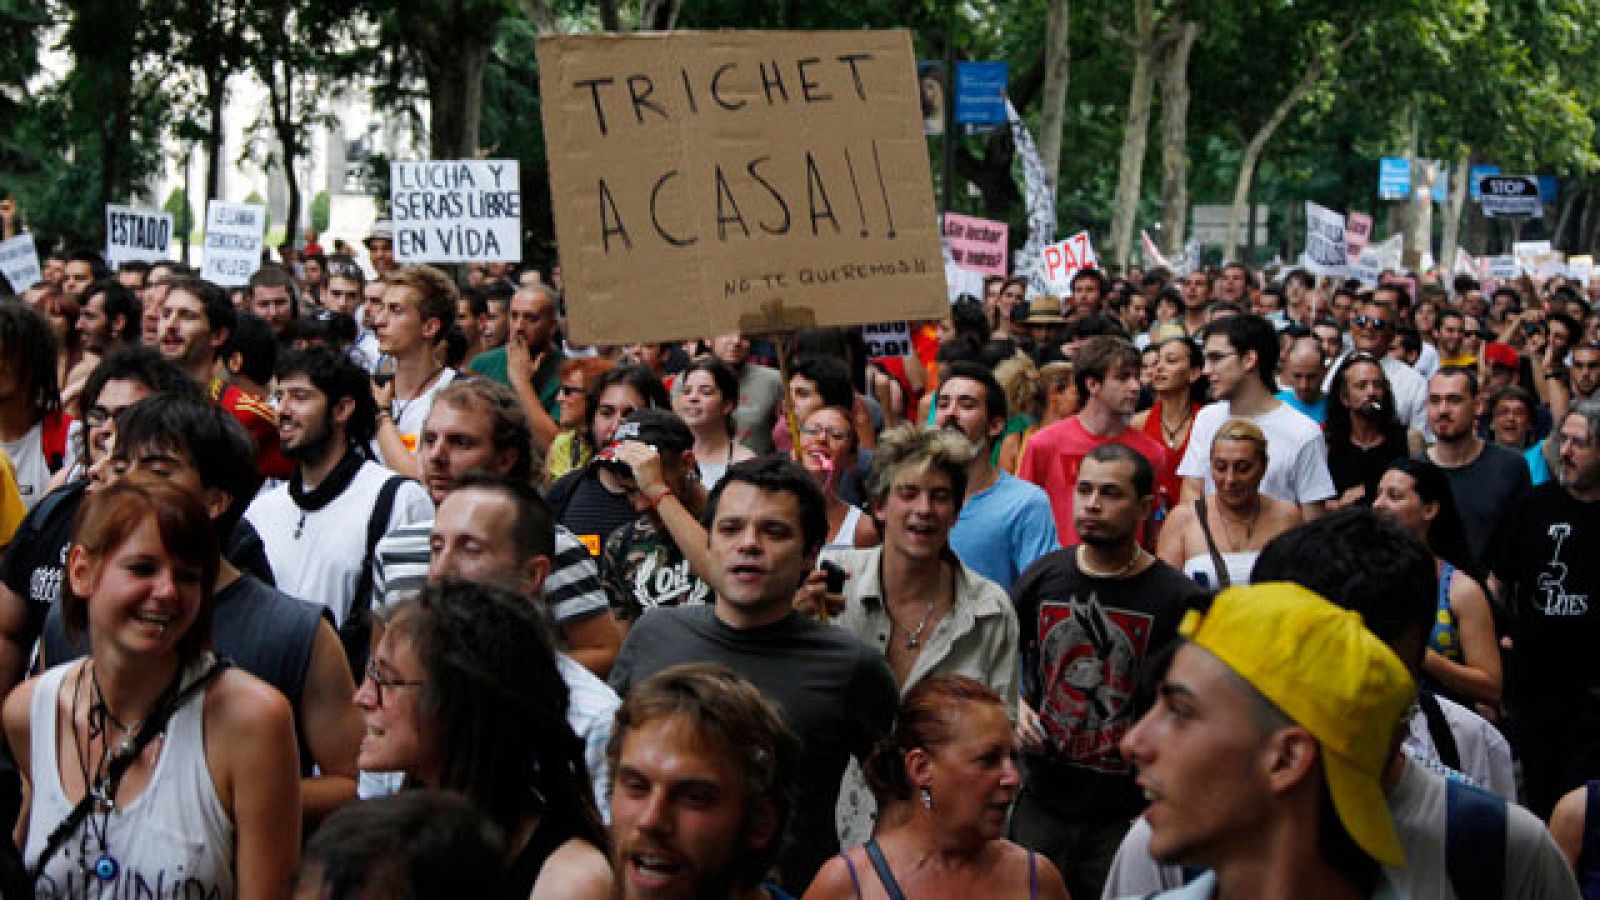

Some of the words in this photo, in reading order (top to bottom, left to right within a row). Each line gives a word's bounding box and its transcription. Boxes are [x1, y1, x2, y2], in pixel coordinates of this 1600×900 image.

[573, 54, 875, 136] TRICHET
[399, 164, 476, 189] LUCHA
[487, 164, 504, 189] Y
[1490, 179, 1526, 194] STOP
[599, 178, 633, 254] A
[648, 138, 896, 246] CASA!!
[110, 211, 170, 252] ESTADO
[399, 228, 426, 257] EN
[1045, 234, 1094, 280] PAZ
[724, 278, 751, 297] NO
[762, 271, 786, 288] TE
